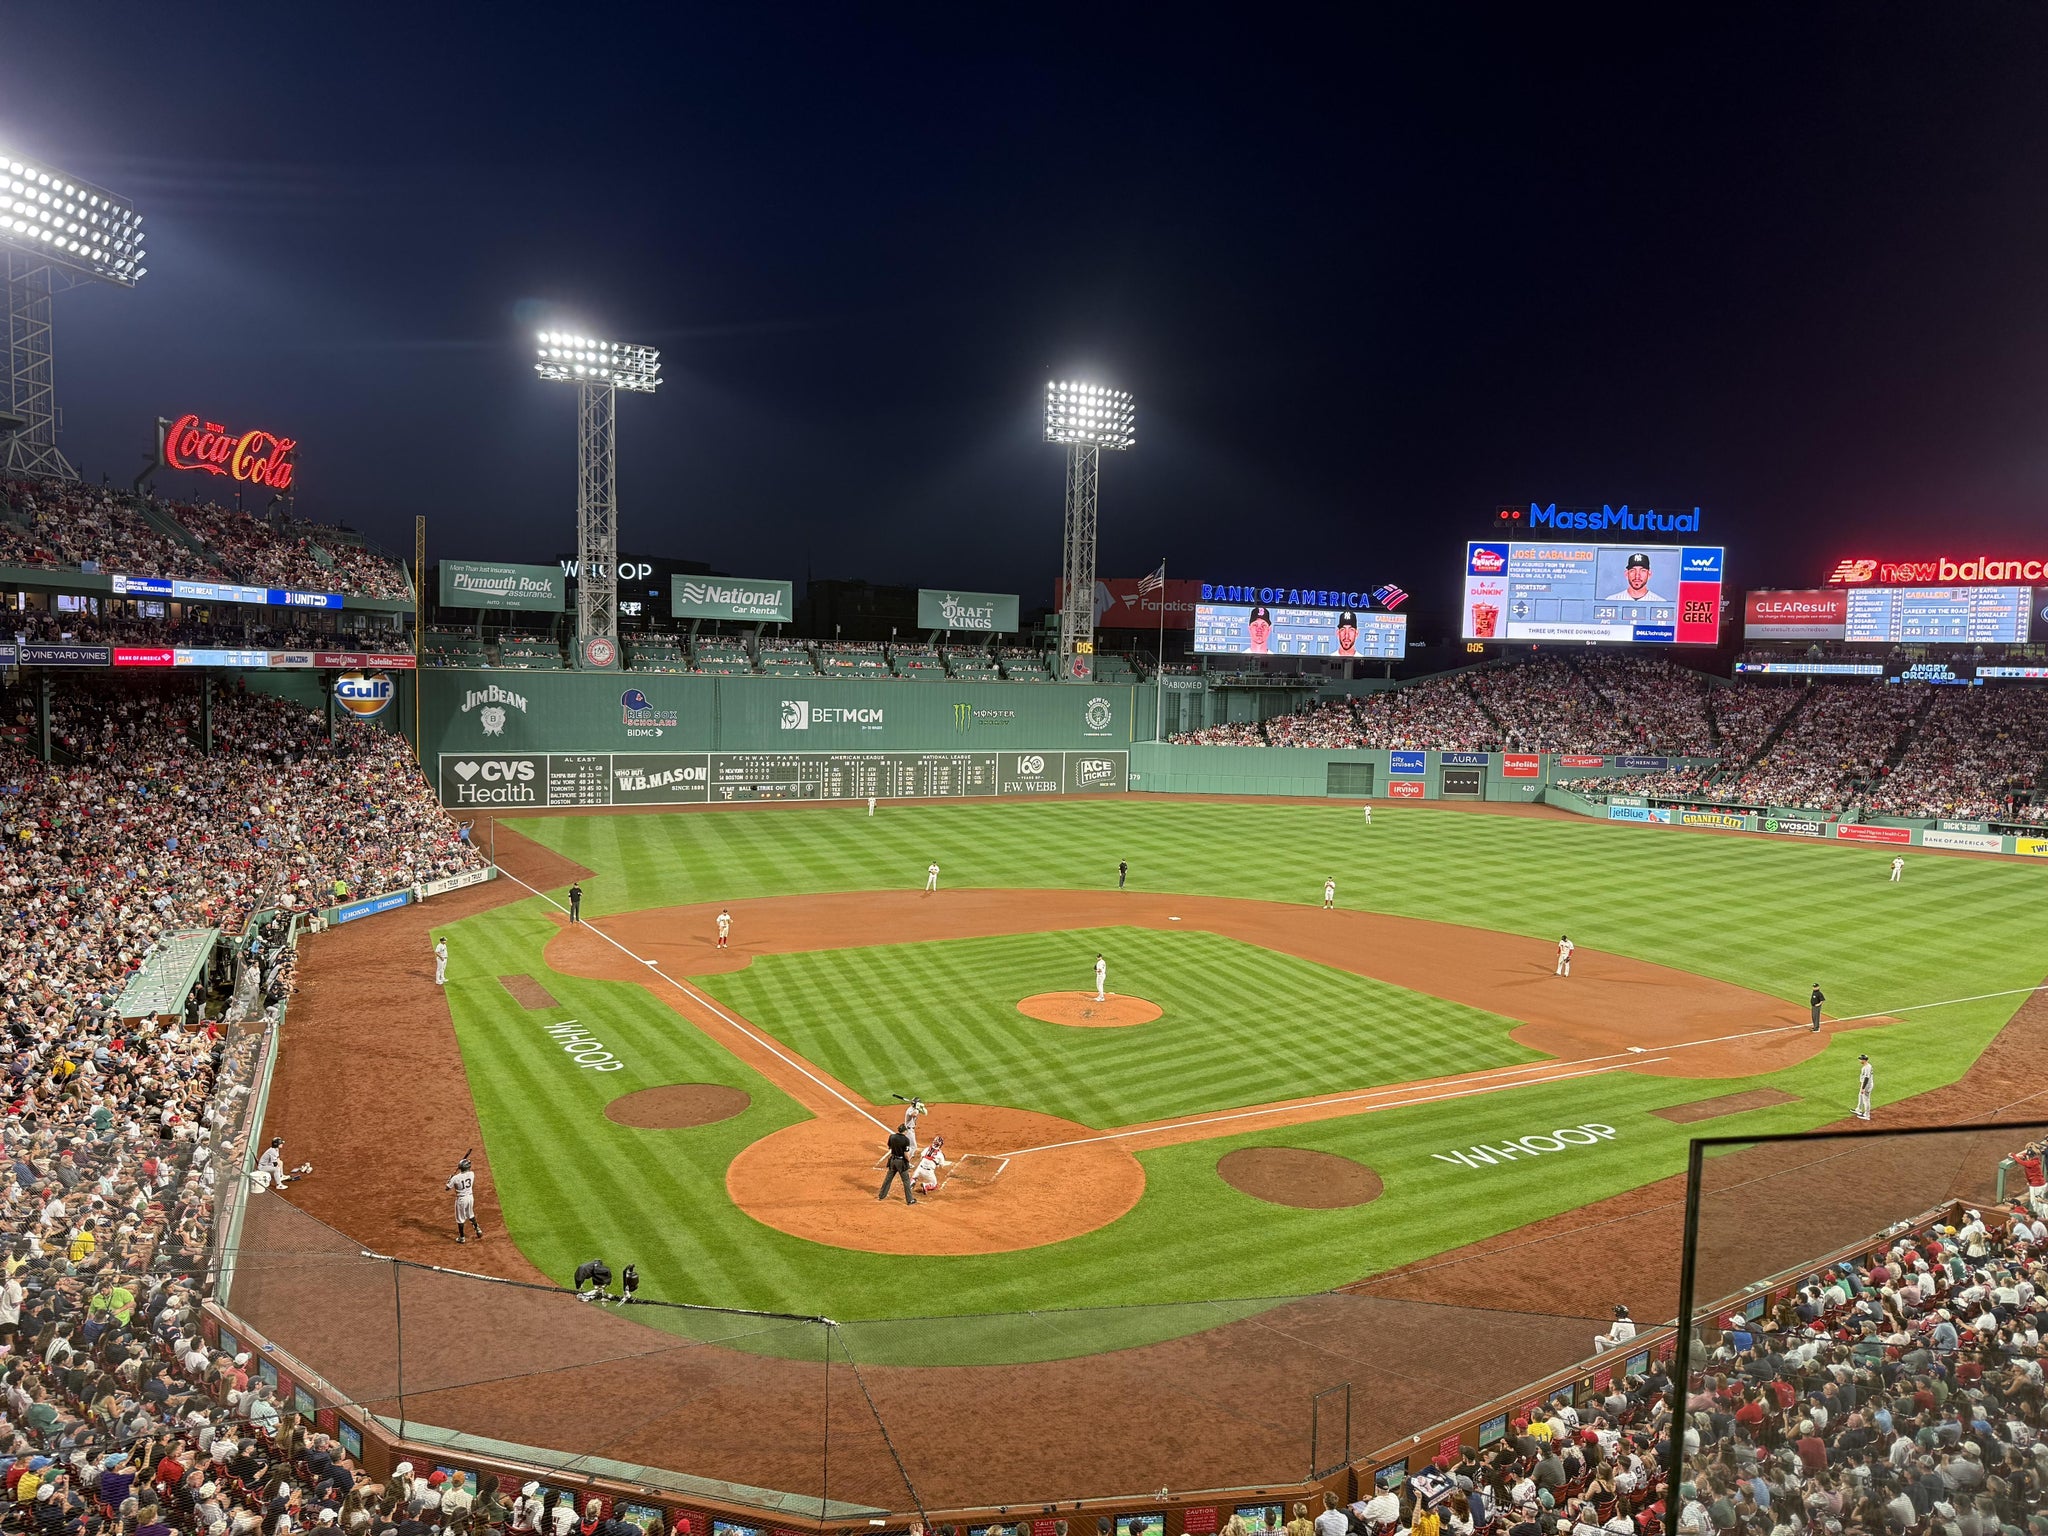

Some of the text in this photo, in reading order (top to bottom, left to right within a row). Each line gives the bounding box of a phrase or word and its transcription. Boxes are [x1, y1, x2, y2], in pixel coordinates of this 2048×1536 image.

[166, 414, 296, 489] Coca-Cola
[1529, 502, 1700, 532] MassMutual
[1512, 548, 1593, 561] JOSÉ CABALLERO
[450, 564, 464, 572] More
[1880, 563, 1937, 583] new
[1939, 556, 2048, 581] balanc
[453, 573, 552, 592] Plymouth Rock
[180, 586, 195, 594] PITCH
[196, 587, 213, 595] BREAK
[705, 586, 781, 606] National
[1201, 583, 1370, 609] BANK OF AMERICA
[1471, 588, 1504, 596] DUNKIN'
[1905, 591, 1950, 599] CABALLERO
[295, 593, 327, 606] UNITED
[732, 605, 778, 615] Car Rental
[1141, 600, 1195, 611] Fanatics
[1685, 601, 1713, 612] SEAT
[1756, 601, 1836, 612] CLEAResult
[942, 605, 994, 619] DRAFT
[1597, 608, 1668, 619] .251 8 28
[949, 618, 992, 629] KINGS
[1683, 612, 1713, 624] GEEK
[1076, 642, 1093, 654] 0:05
[1281, 643, 1287, 652] 0
[1301, 643, 1307, 653] 2
[1467, 642, 1484, 653] 0:05
[31, 651, 107, 660] VINEYARD VINES
[1909, 663, 1948, 673] ANGRY
[1902, 671, 1956, 680] ORCHARD
[336, 681, 390, 698] Gulf
[1168, 681, 1202, 689] ABIOMED
[461, 684, 528, 714] JIM BEAM
[627, 710, 678, 719] RED SOX
[812, 708, 883, 723] BETMGM
[973, 709, 1016, 718] MONSTER
[627, 719, 678, 727] SCHOLARS
[627, 729, 654, 737] BIDMC
[1017, 755, 1045, 774] 160
[1392, 756, 1404, 764] city
[1578, 758, 1603, 766] TICKET
[481, 760, 535, 781] CVS
[1084, 760, 1112, 773] ACE
[614, 769, 630, 777] WHO
[1084, 770, 1112, 780] TICKET
[1025, 781, 1057, 792] WEBB
[457, 782, 535, 803] Health
[1612, 807, 1644, 819] jetBlue
[1683, 814, 1722, 824] GRANITE
[1723, 816, 1744, 828] CITY
[1780, 821, 1819, 832] wasabi
[1943, 821, 1967, 831] DICK'S
[1953, 839, 1985, 847] AMERICA
[543, 1020, 624, 1072] WHOOP
[1430, 1123, 1616, 1168] WHOOP
[461, 1178, 472, 1190] 13
